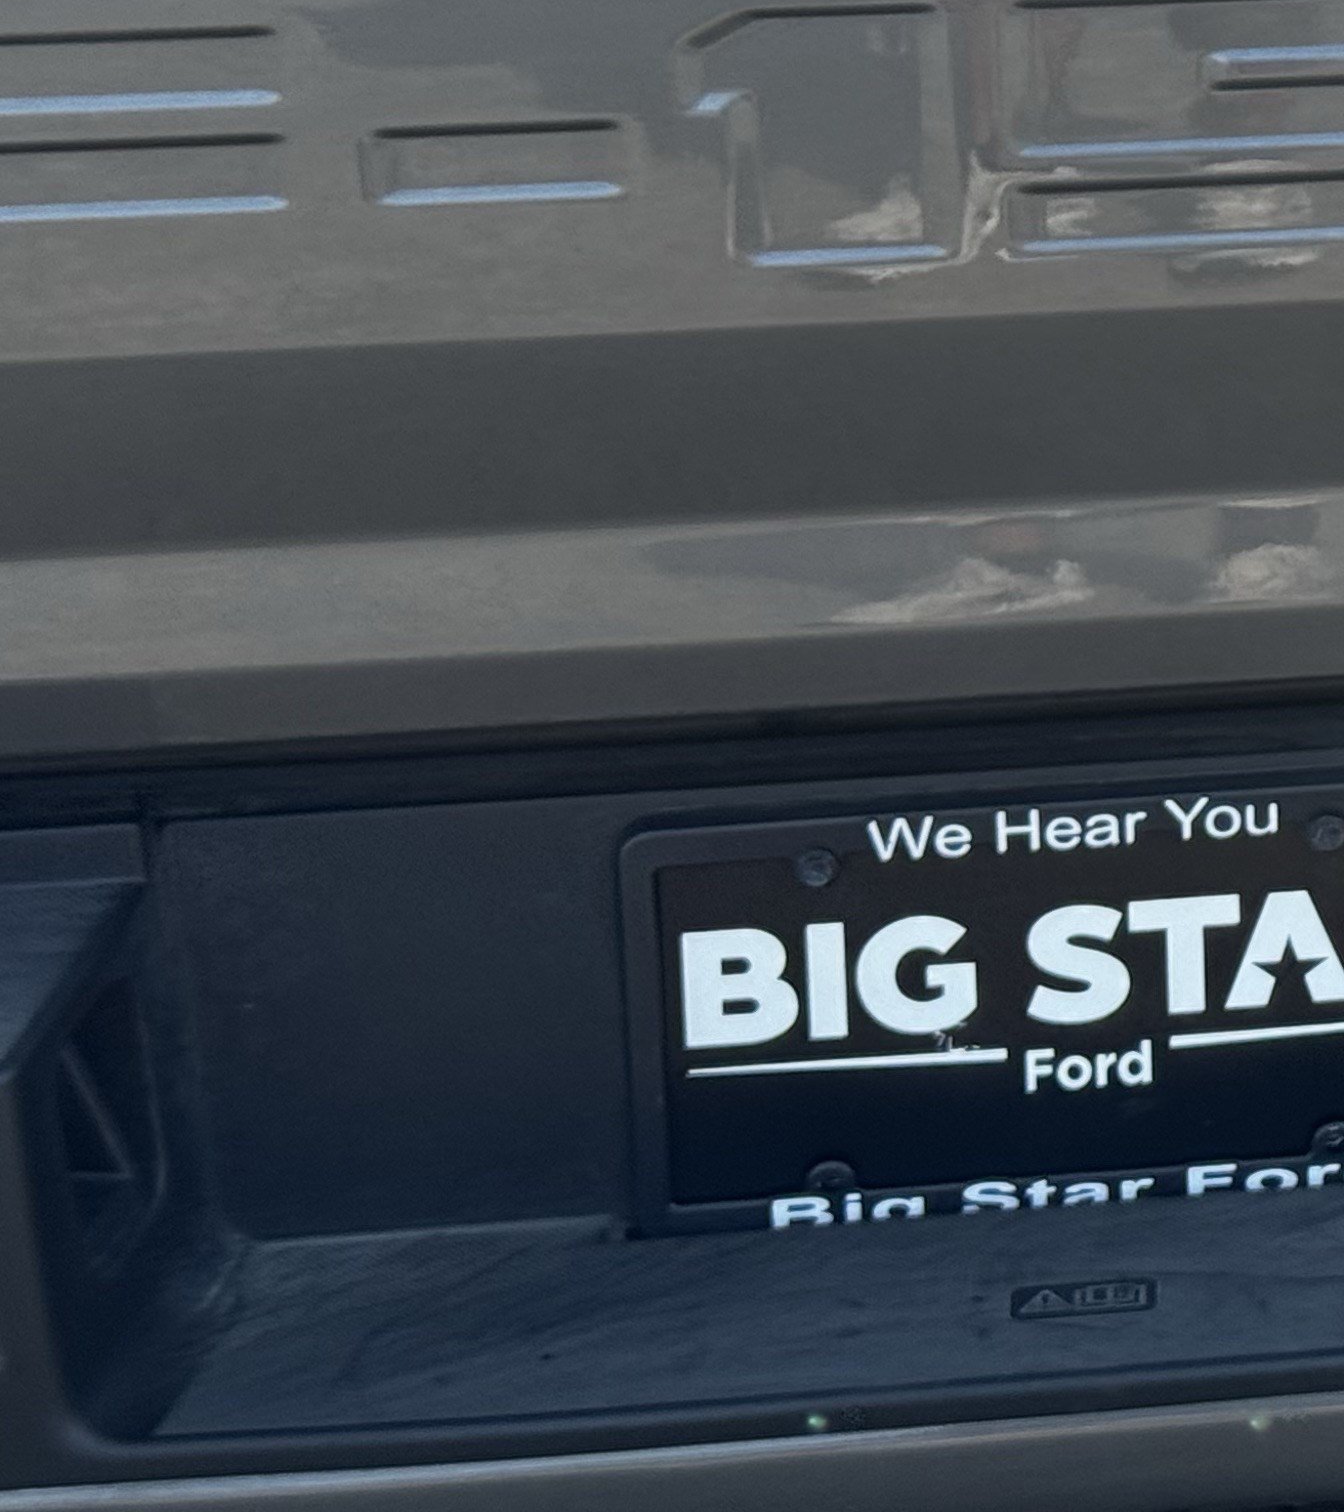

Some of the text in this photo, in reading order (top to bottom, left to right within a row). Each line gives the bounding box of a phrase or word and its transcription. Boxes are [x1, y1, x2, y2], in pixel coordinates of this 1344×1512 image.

[867, 795, 1280, 864] We Hear You
[680, 914, 979, 1049] BIG
[1024, 1038, 1154, 1093] Ford
[961, 1176, 1155, 1216] Star
